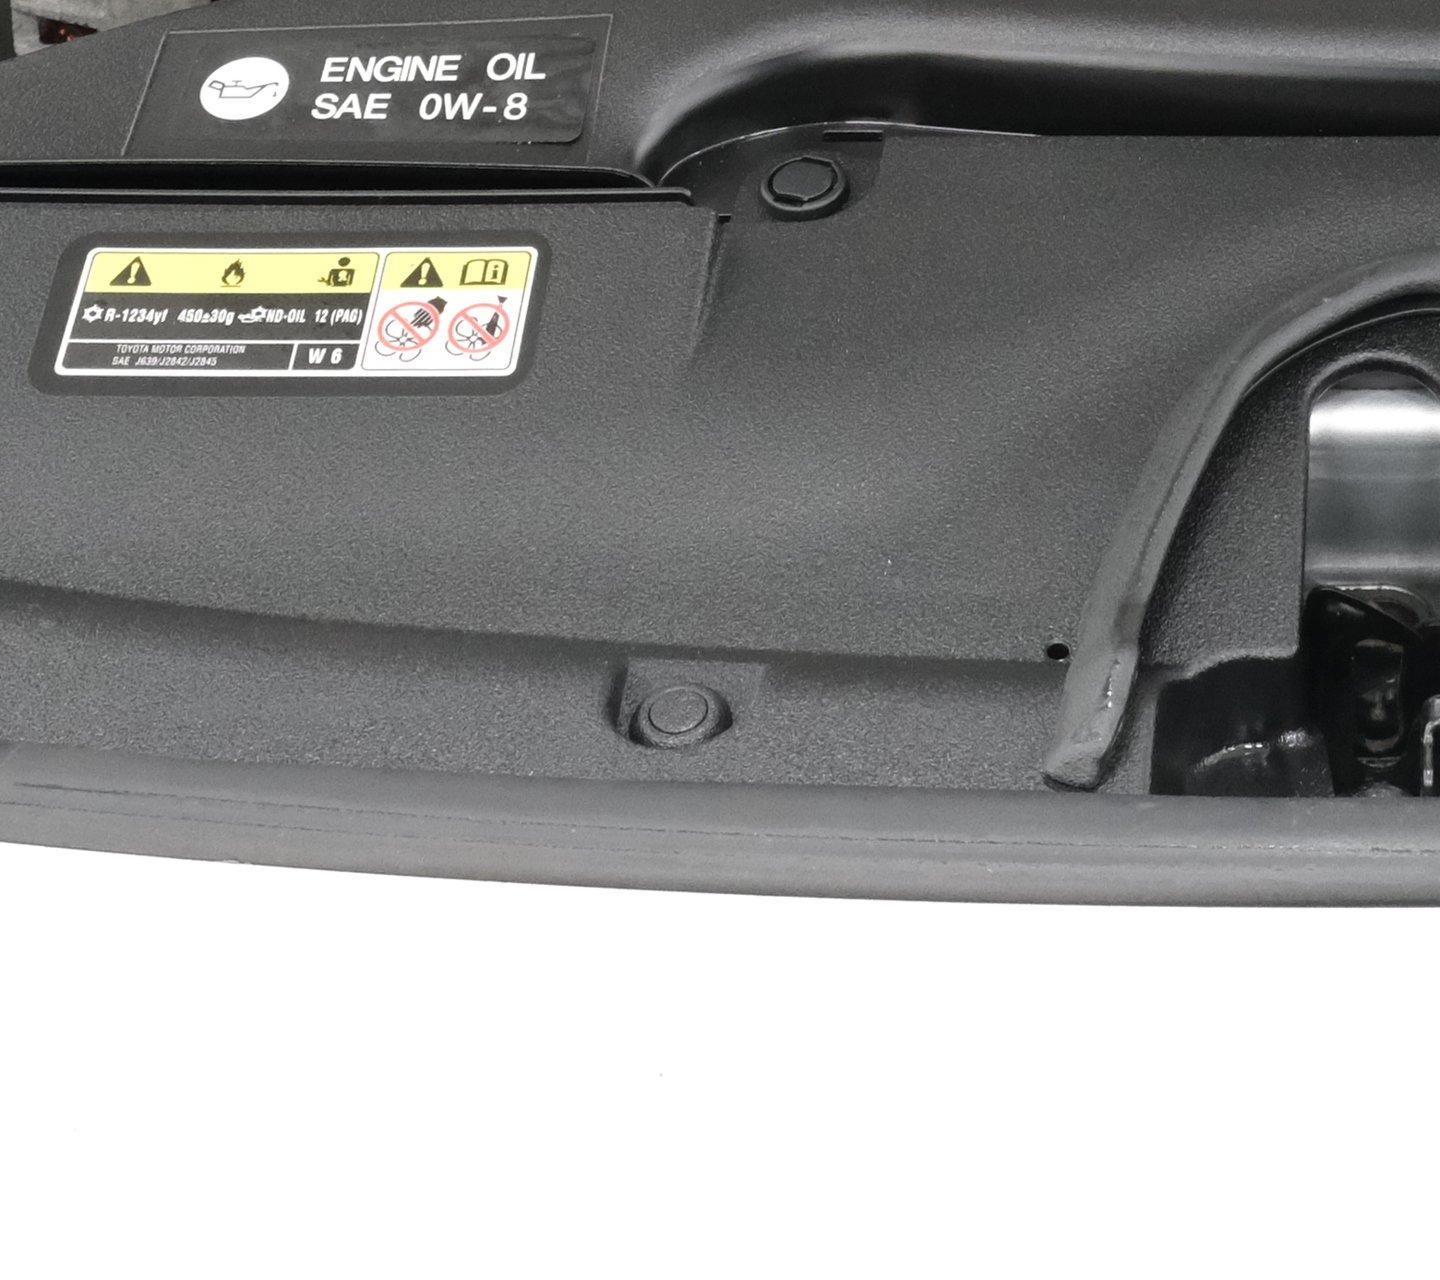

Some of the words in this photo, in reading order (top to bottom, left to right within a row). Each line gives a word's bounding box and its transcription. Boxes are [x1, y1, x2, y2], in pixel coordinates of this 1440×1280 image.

[320, 54, 462, 83] ENGINE
[486, 52, 547, 81] OIL
[310, 92, 393, 120] SAE
[418, 92, 529, 121] 0W-8
[104, 307, 169, 325] R-1234yf
[314, 308, 329, 323] 12
[330, 308, 364, 326] (PAG)
[116, 344, 150, 354] TOYOTA
[151, 344, 184, 354] MOTOR
[185, 344, 247, 355] CORPORATION
[308, 348, 326, 364] W
[330, 348, 343, 364] 6
[111, 356, 131, 366] SAE
